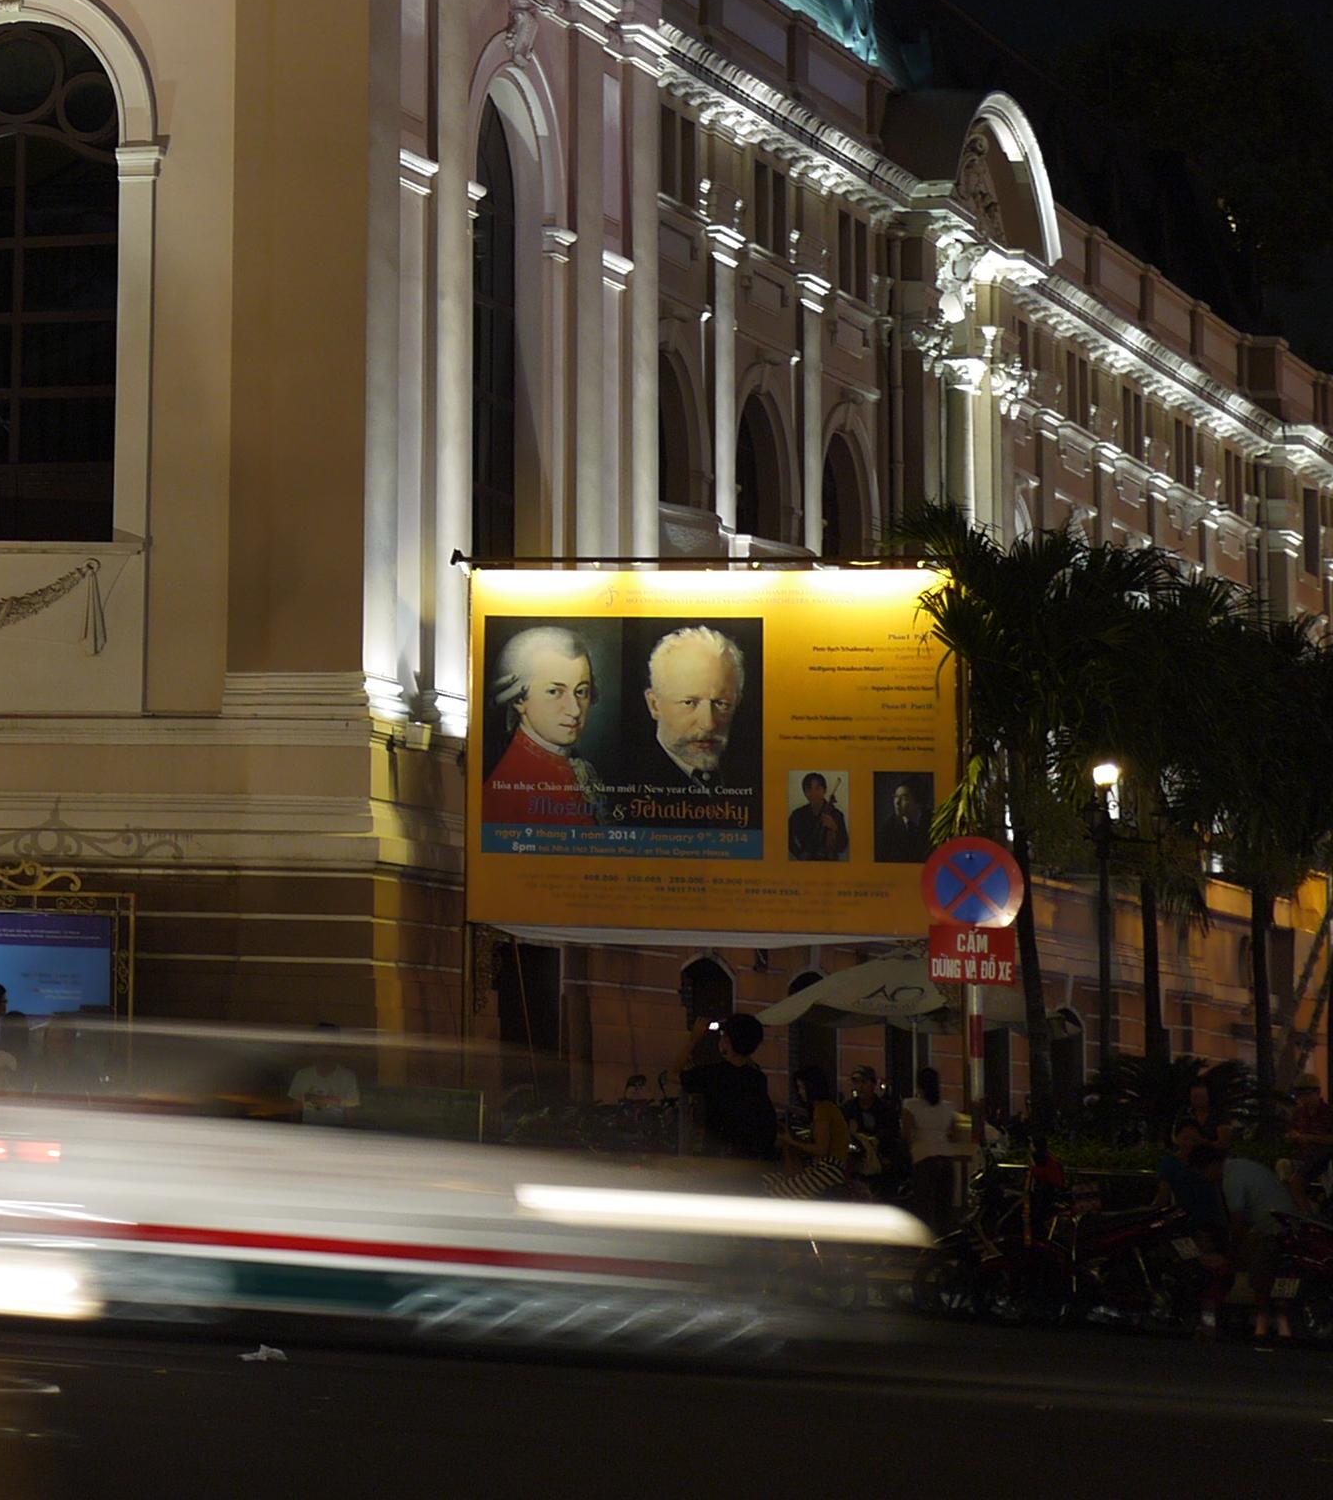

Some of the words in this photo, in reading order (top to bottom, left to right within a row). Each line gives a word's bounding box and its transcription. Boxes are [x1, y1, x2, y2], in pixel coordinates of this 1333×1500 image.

[644, 784, 666, 794] New
[666, 786, 686, 796] year
[688, 785, 711, 795] Gala
[714, 785, 753, 796] Concert
[613, 803, 627, 820] &
[630, 795, 749, 828] Tchaikovsky
[525, 827, 533, 837] 9
[571, 829, 576, 839] 1
[608, 830, 637, 840] 2014
[650, 831, 694, 844] January
[718, 832, 749, 844] 2014
[511, 841, 536, 853] 8pm
[957, 928, 988, 953] CẤM
[965, 956, 977, 979] VÀ
[998, 961, 1012, 981] XE
